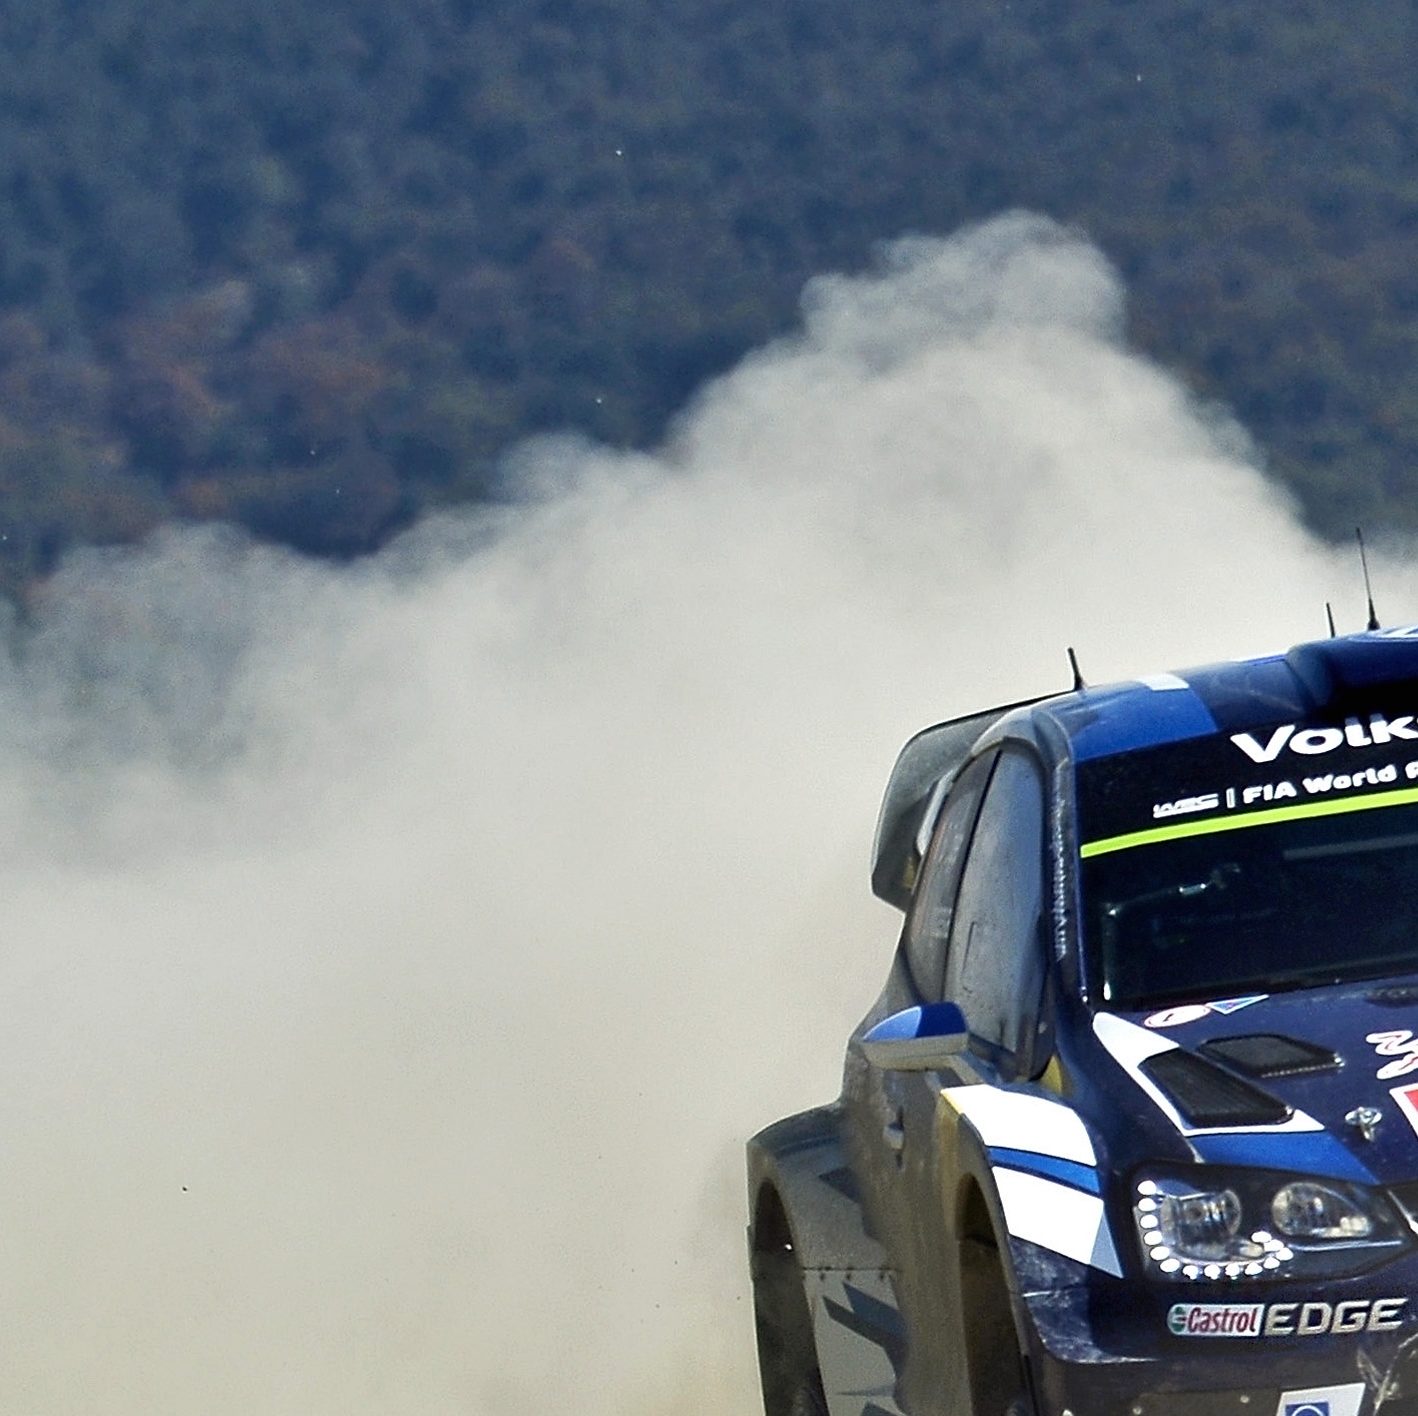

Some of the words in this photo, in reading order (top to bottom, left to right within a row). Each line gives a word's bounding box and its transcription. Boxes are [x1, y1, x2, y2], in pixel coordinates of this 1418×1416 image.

[1242, 781, 1298, 803] FIA
[1302, 764, 1397, 794] World
[1187, 1306, 1259, 1333] Castrol
[1264, 1298, 1409, 1336] EDGE
